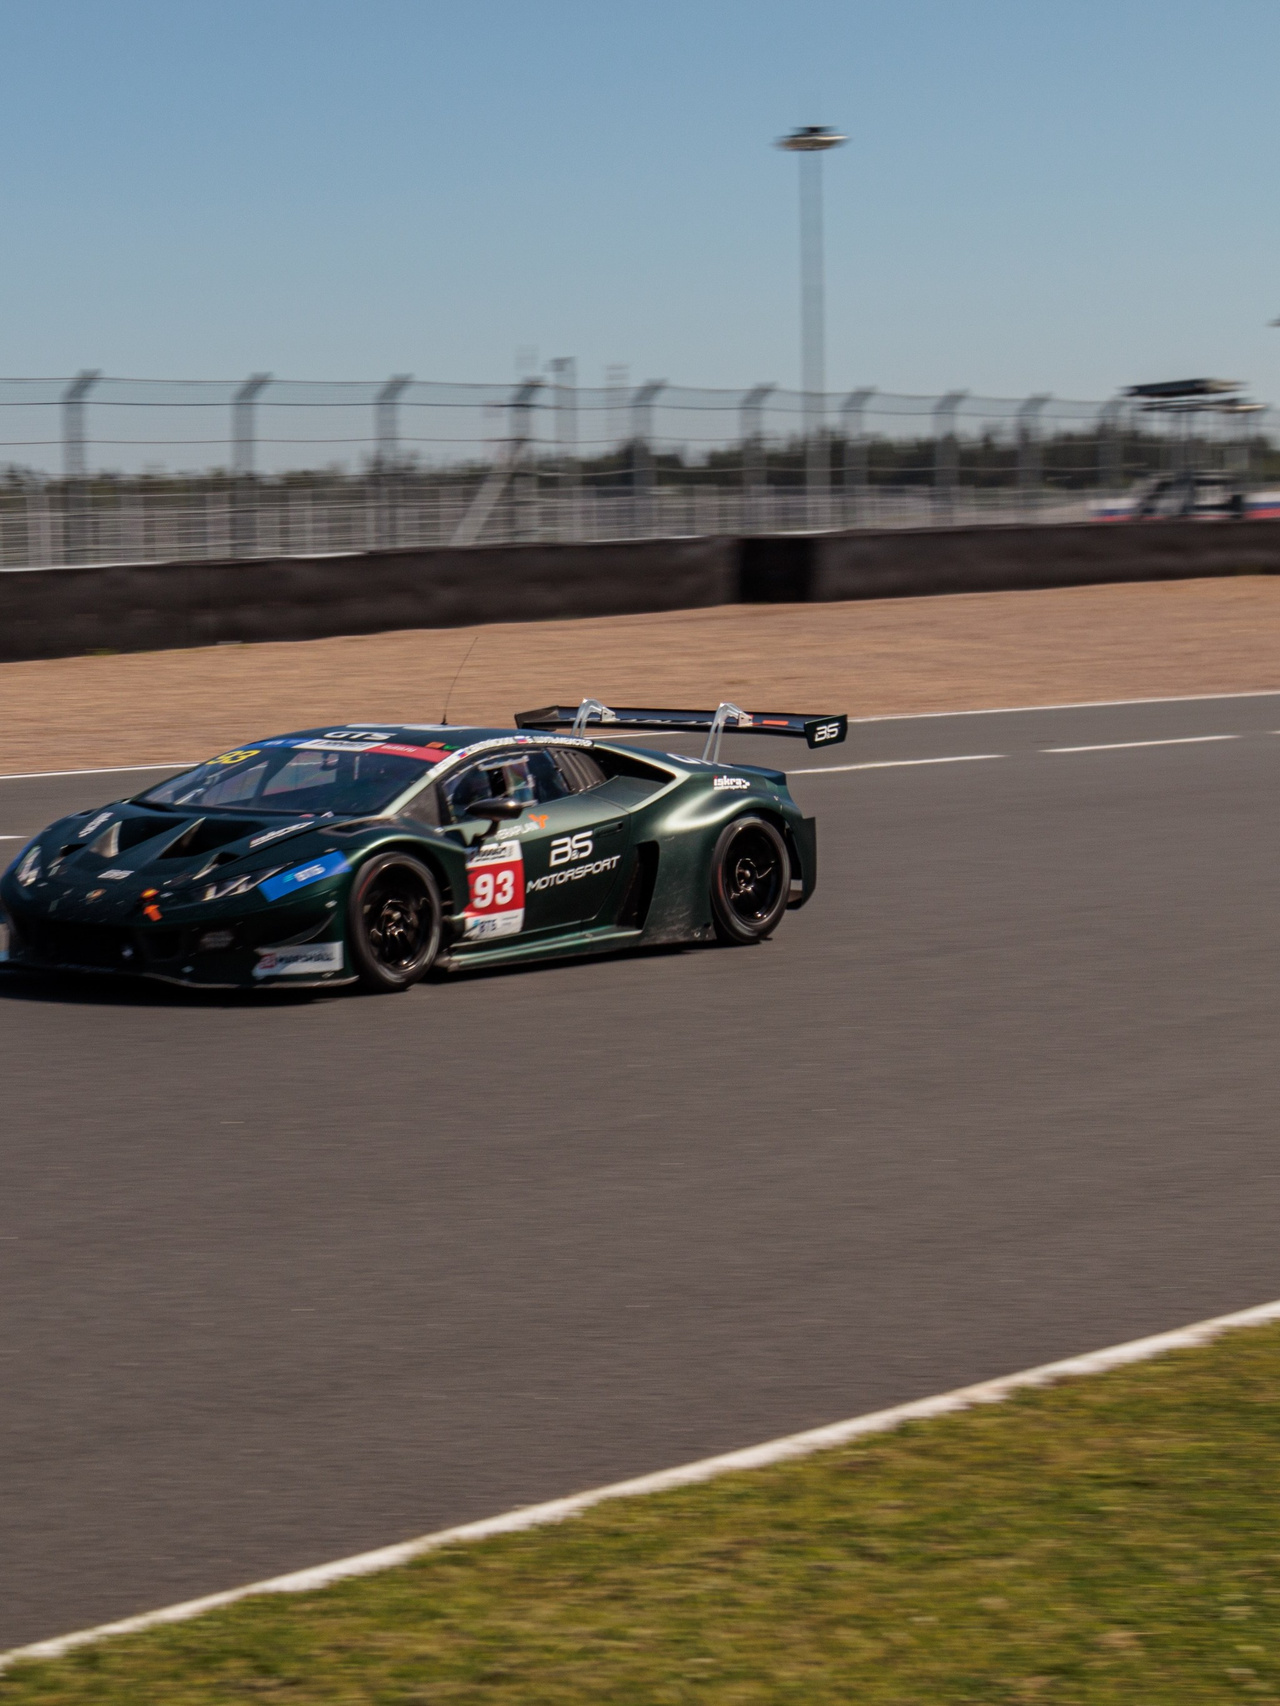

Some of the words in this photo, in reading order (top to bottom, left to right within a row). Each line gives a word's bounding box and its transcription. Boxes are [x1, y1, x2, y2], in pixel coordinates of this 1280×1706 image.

[713, 775, 744, 786] iskra
[472, 870, 515, 909] 93
[526, 854, 621, 894] MOTORSPORT
